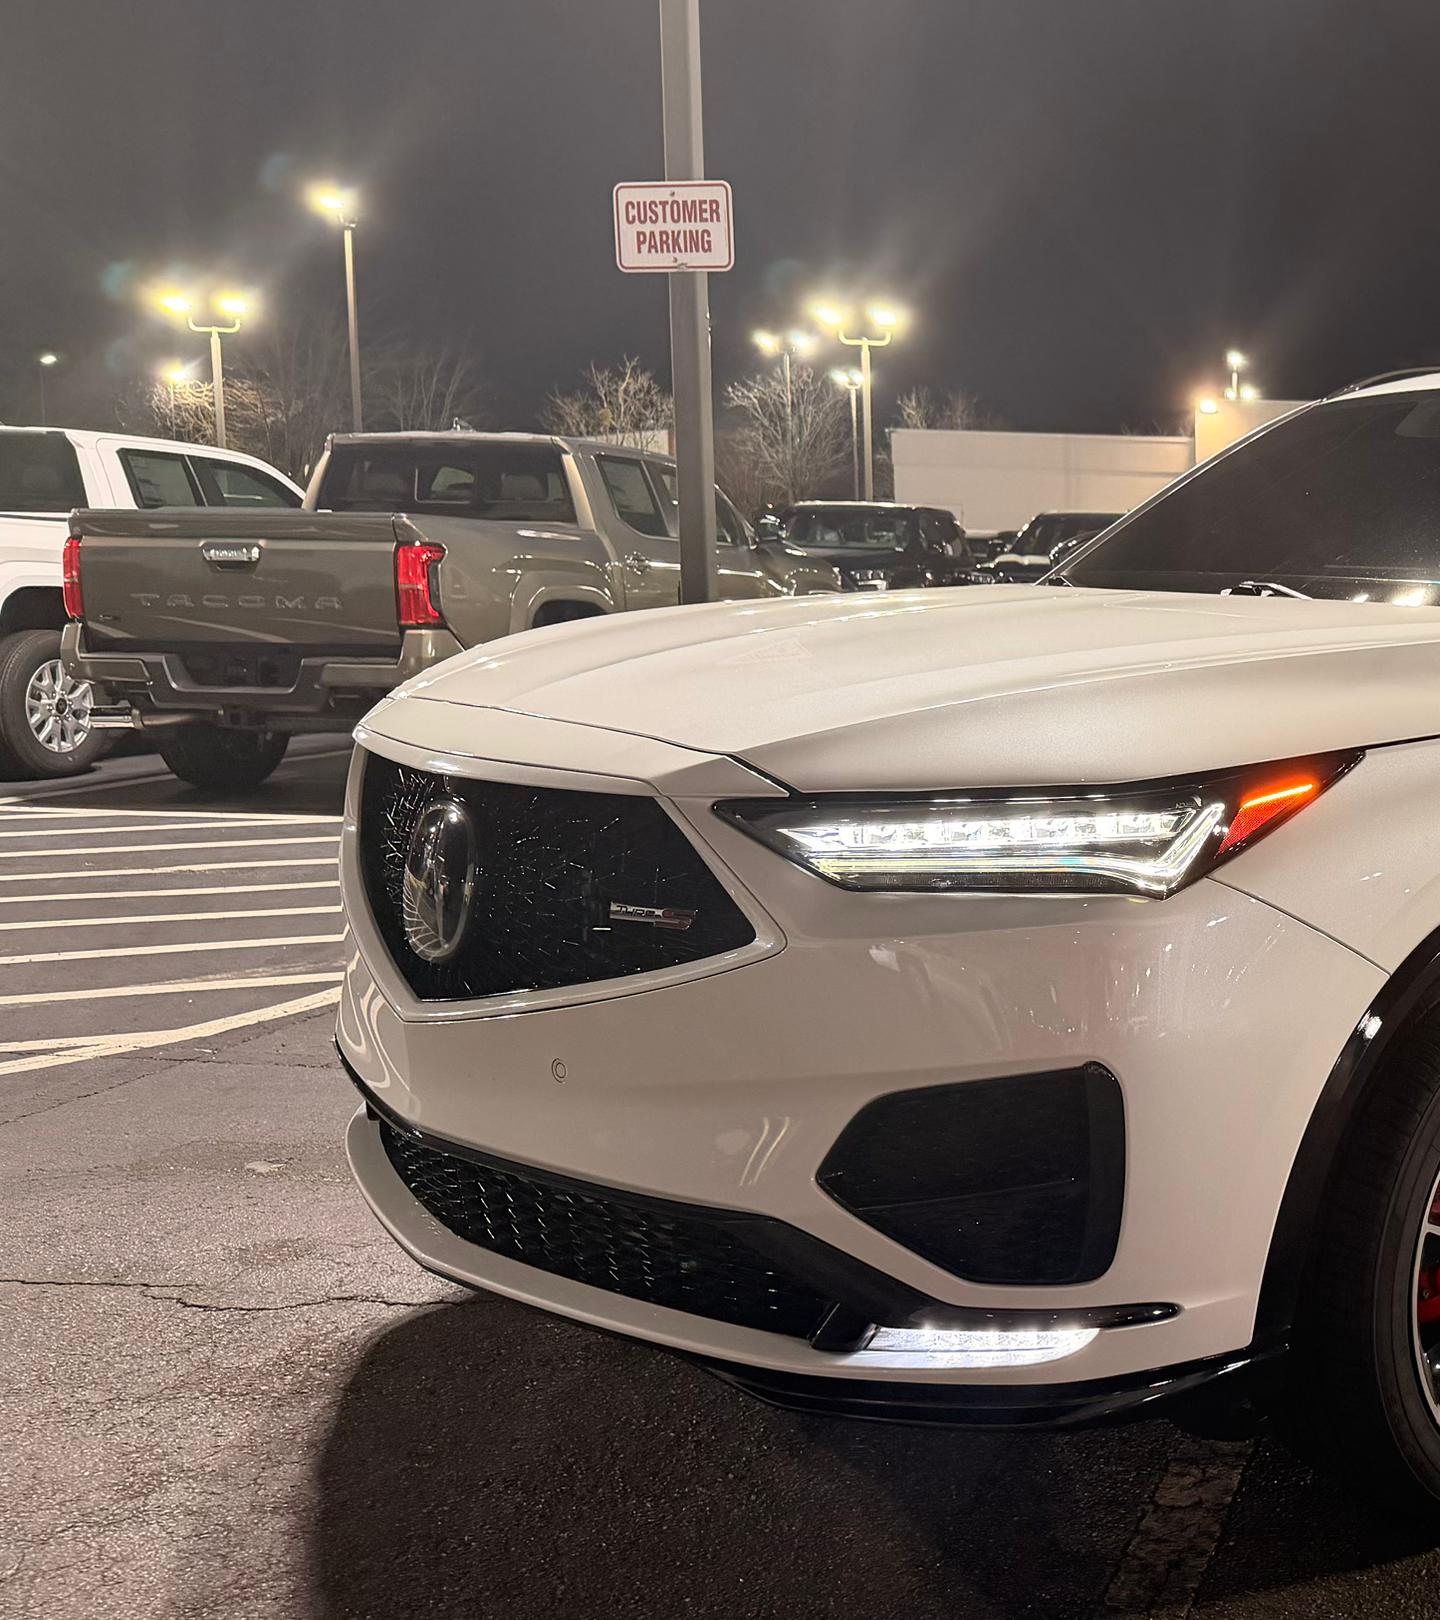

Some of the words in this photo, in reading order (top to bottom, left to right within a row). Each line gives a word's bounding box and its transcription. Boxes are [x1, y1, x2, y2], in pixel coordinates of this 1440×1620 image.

[625, 199, 721, 225] CUSTOMER
[636, 229, 712, 254] PARKING
[130, 593, 343, 610] TACOMA
